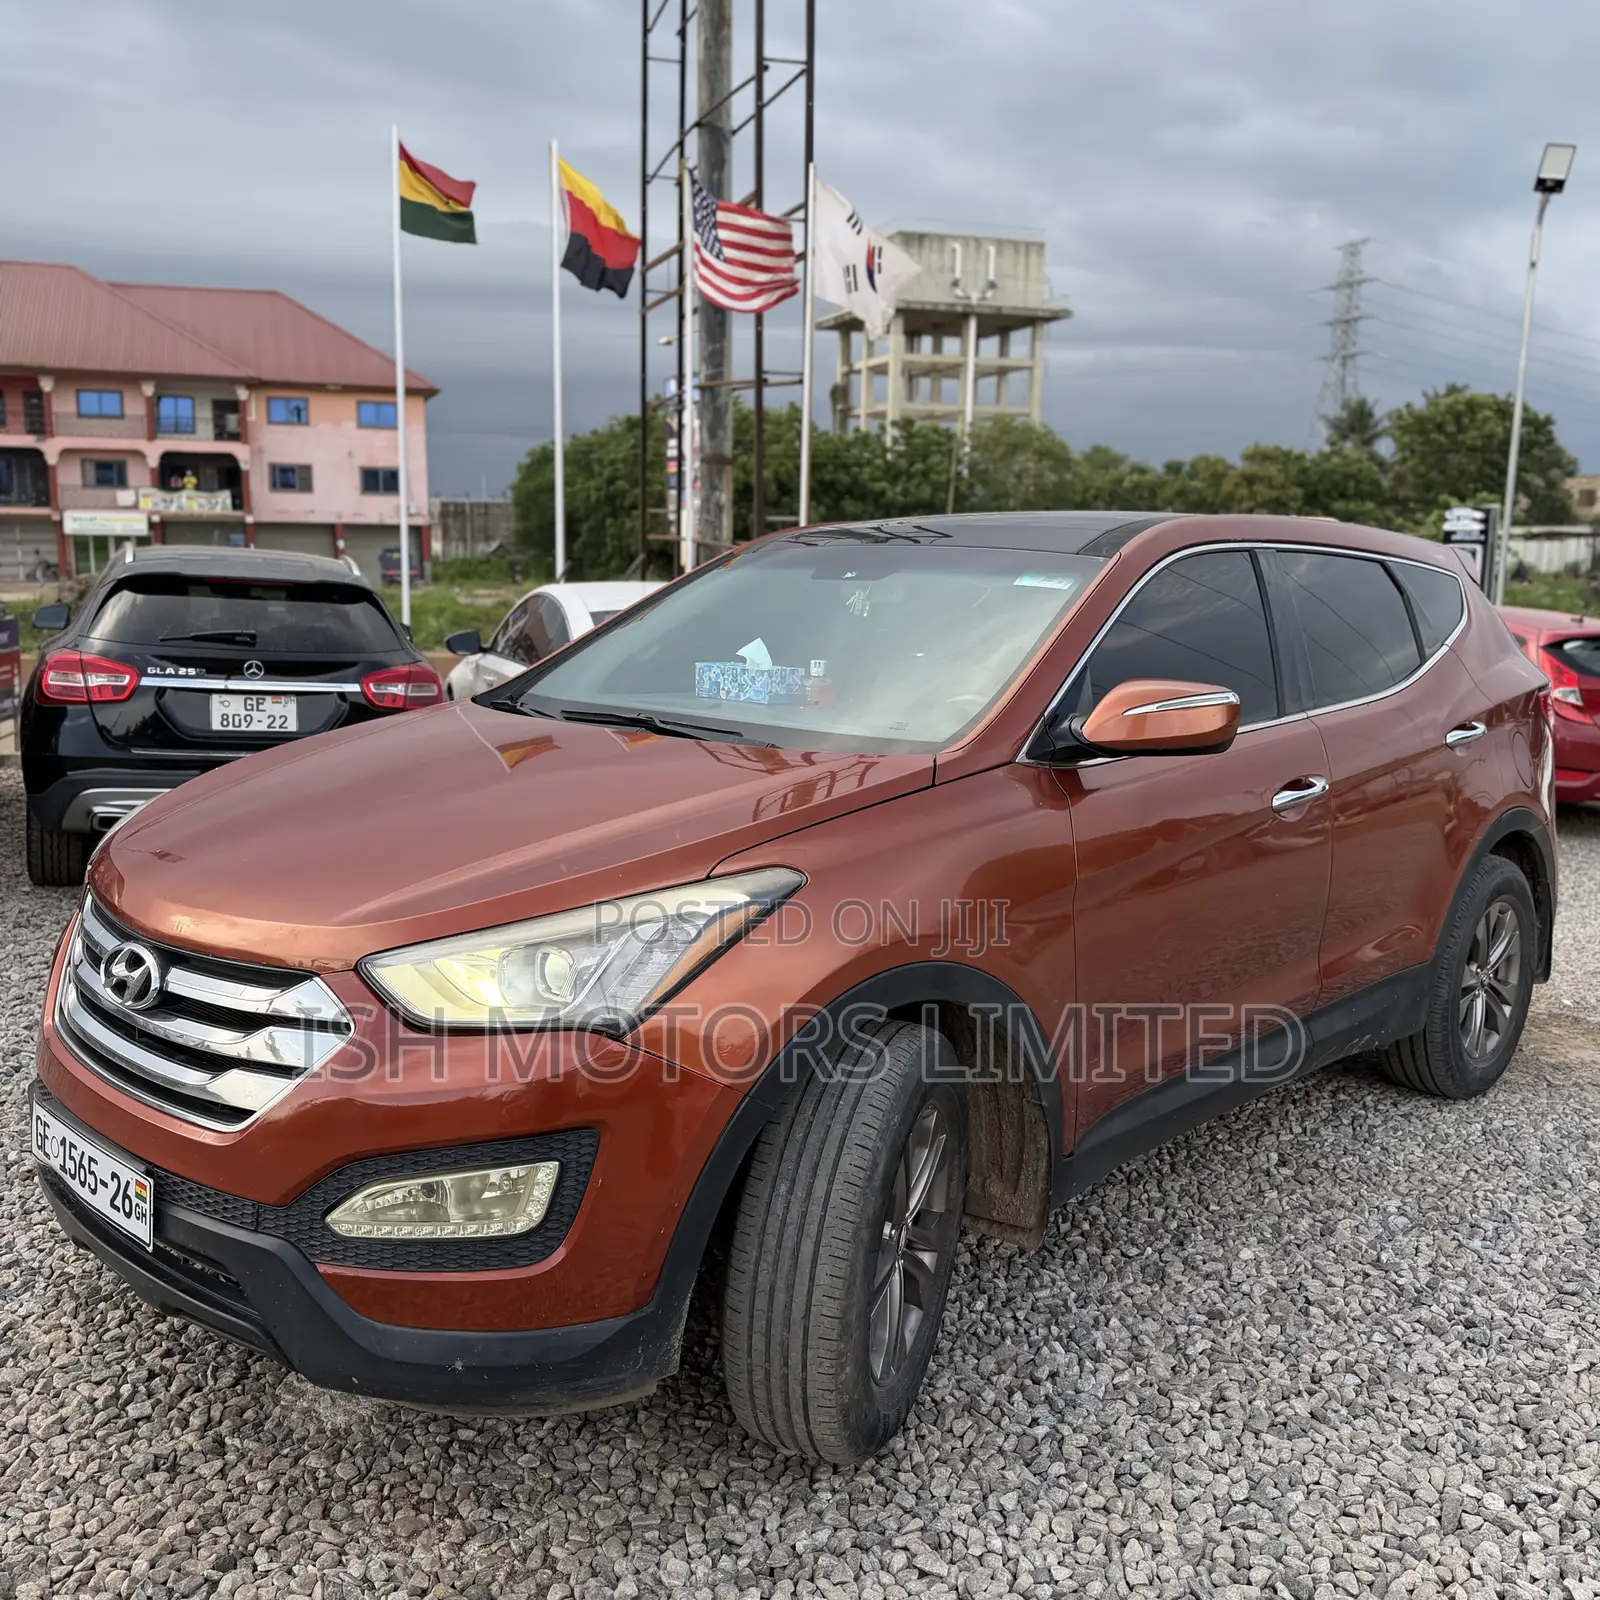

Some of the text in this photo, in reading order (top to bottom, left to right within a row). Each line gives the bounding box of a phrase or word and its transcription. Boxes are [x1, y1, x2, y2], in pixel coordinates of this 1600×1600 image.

[147, 666, 176, 675] GLA
[243, 697, 267, 713] GE
[219, 713, 289, 730] 809-22
[35, 1114, 133, 1220] GE 1565-26
[134, 1203, 148, 1226] GH
